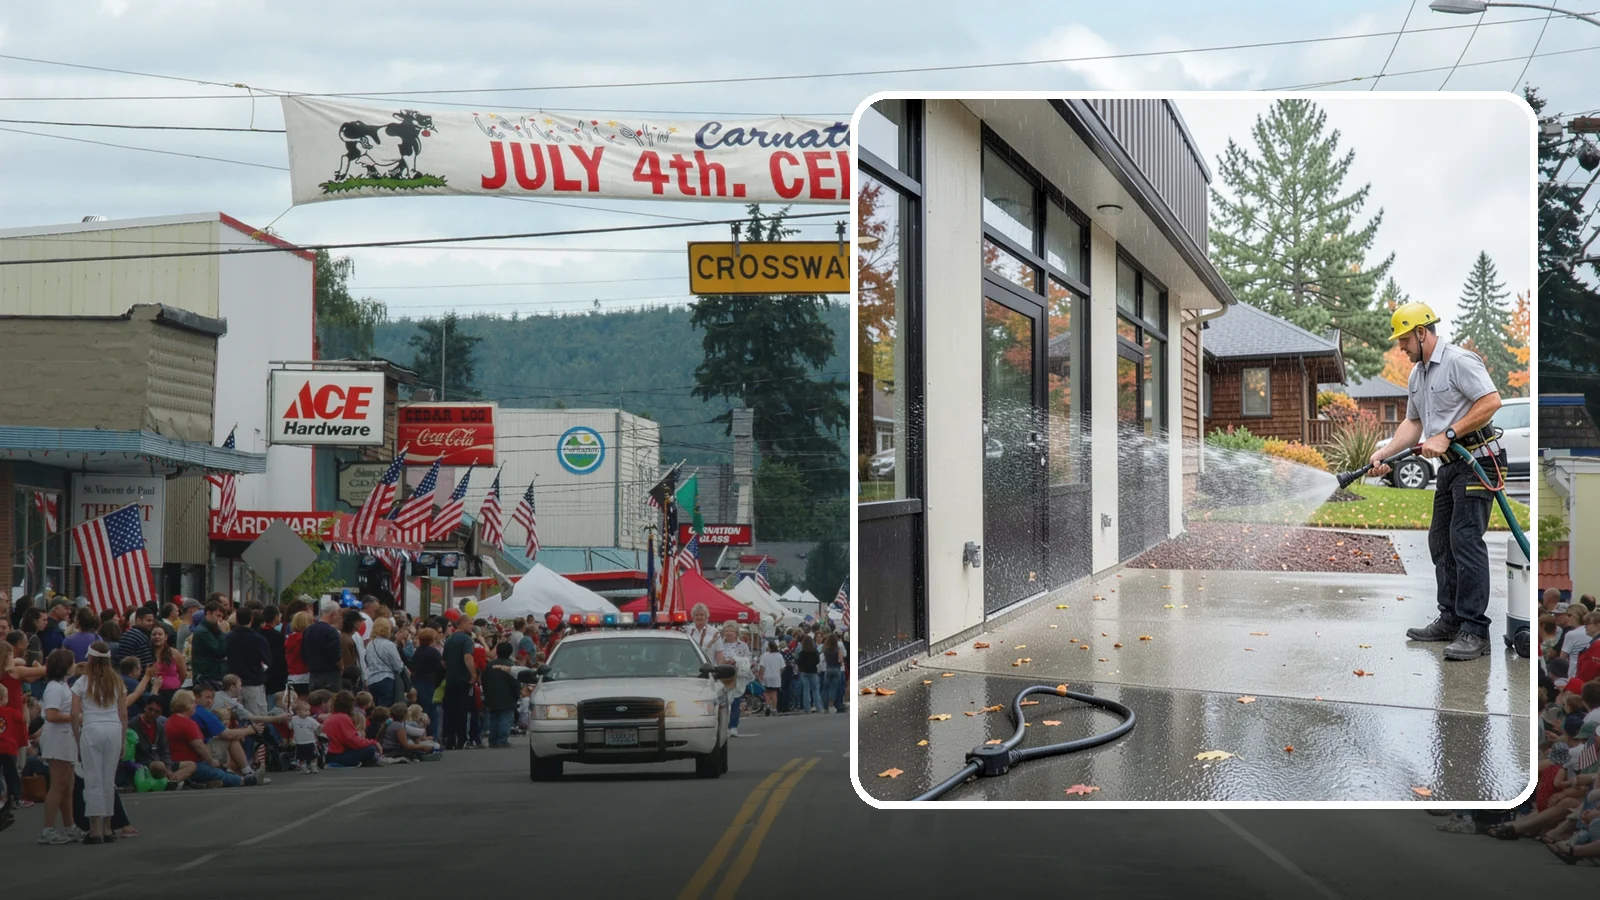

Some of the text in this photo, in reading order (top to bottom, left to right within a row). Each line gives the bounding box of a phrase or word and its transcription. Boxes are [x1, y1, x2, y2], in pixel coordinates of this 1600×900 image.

[481, 141, 605, 193] JULY
[632, 150, 746, 198] 4th.
[697, 254, 850, 280] CROSSWA
[283, 380, 373, 420] ACE
[405, 407, 486, 422] CEDAR LOG
[283, 421, 371, 436] Hardware
[416, 428, 477, 447] Coca-Cola
[353, 467, 384, 481] Simpl
[83, 485, 155, 495] St. Vincent de Paul
[212, 515, 330, 536] HARDARE
[688, 526, 741, 535] CRNATION
[699, 535, 730, 544] GLASS
